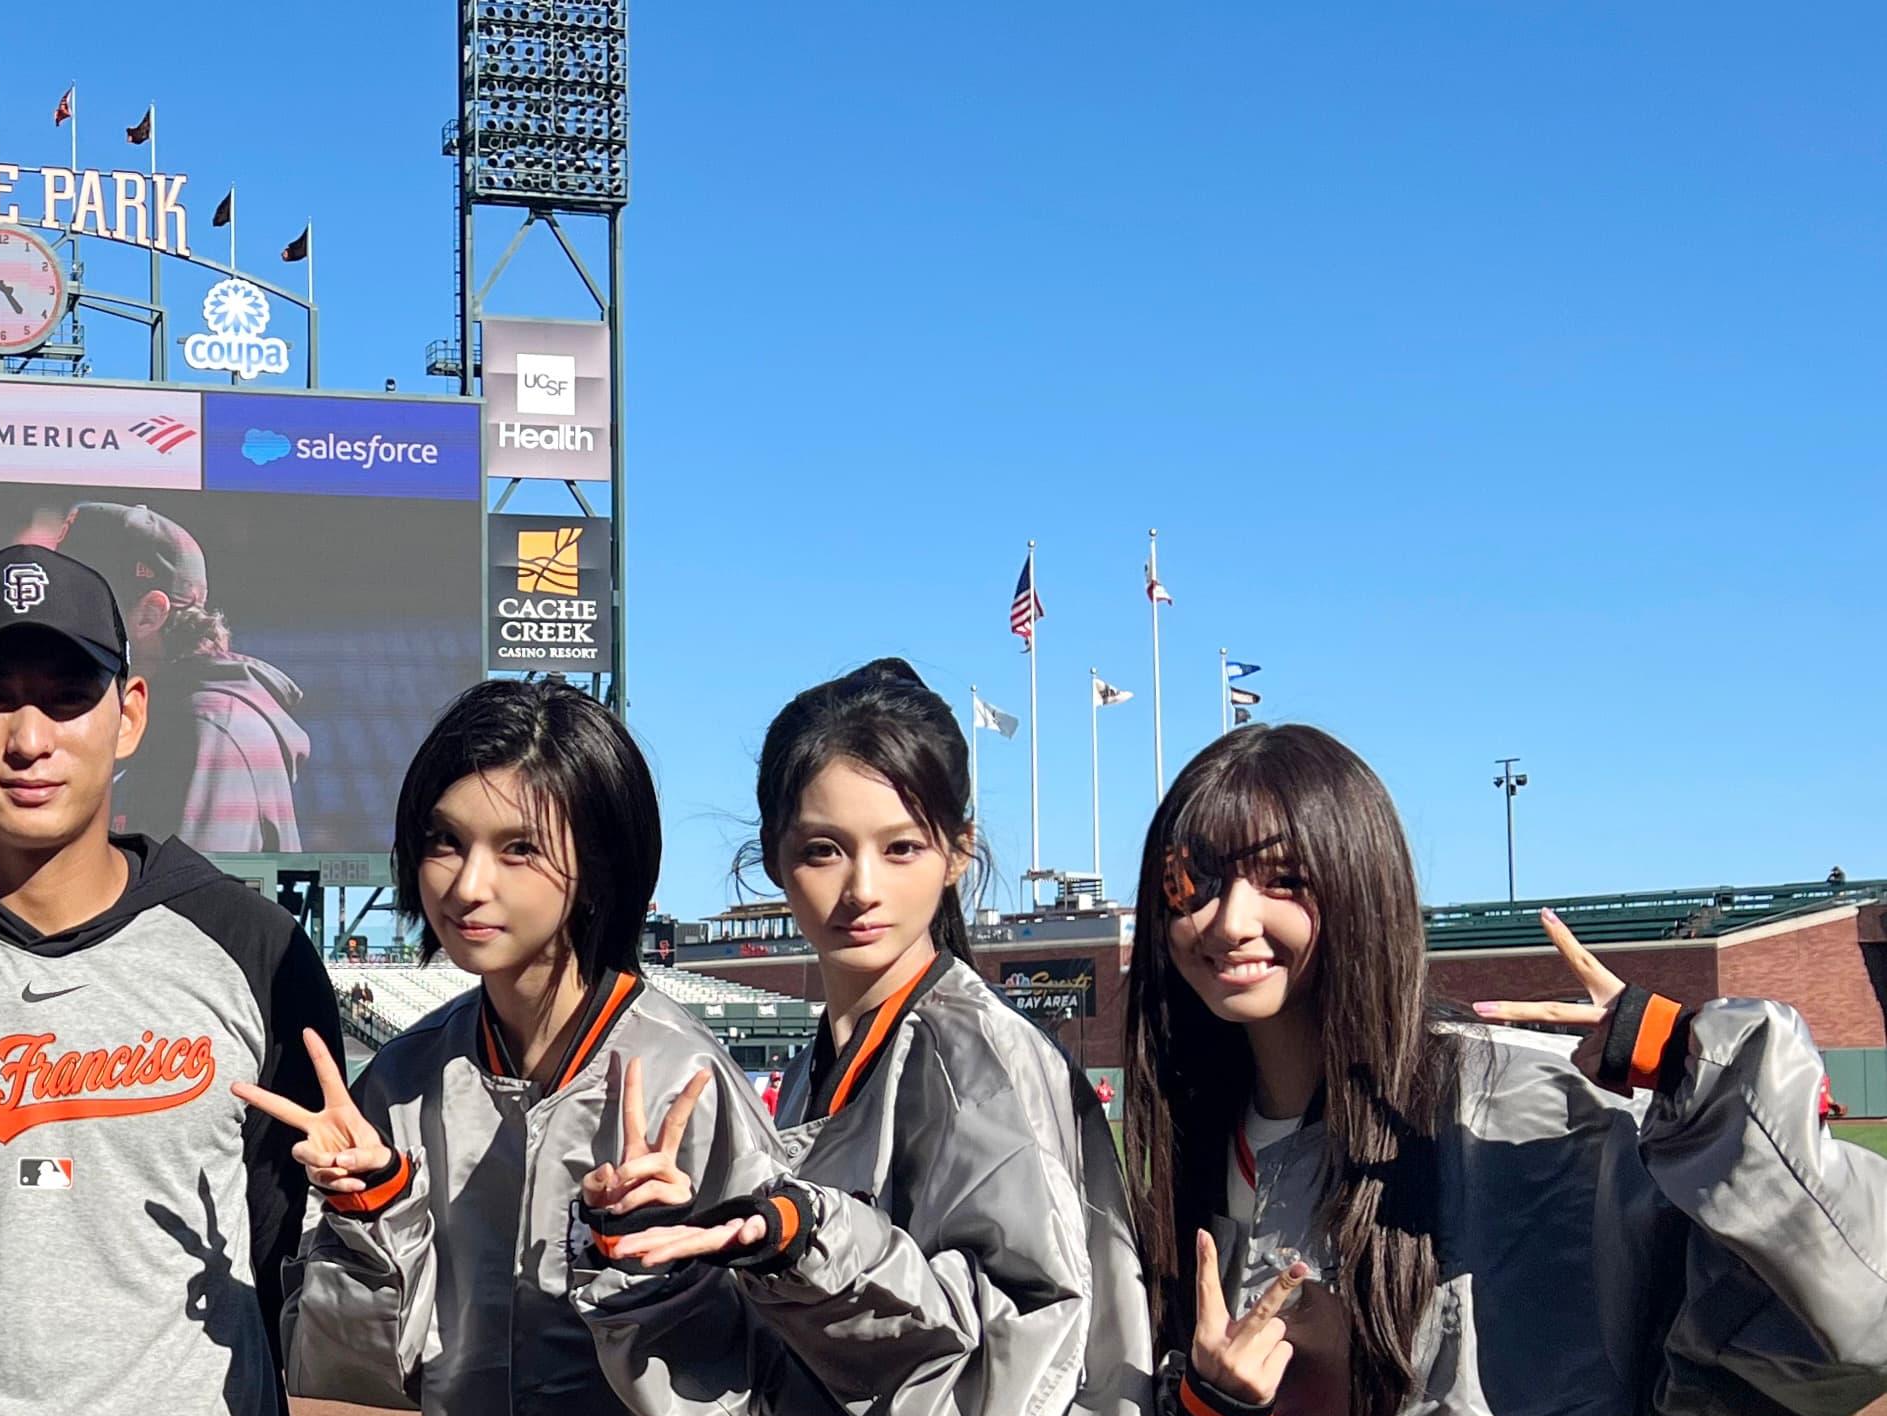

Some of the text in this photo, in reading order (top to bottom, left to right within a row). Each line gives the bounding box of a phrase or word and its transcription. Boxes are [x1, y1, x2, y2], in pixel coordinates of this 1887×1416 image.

[40, 166, 191, 258] PARK
[24, 242, 31, 252] 1
[41, 262, 49, 272] 2
[49, 286, 55, 296] 3
[41, 309, 49, 320] 4
[0, 331, 7, 341] 6
[23, 325, 31, 336] 5
[191, 338, 282, 372] coupa
[524, 373, 569, 396] UCSF
[498, 421, 594, 452] Health
[296, 433, 439, 469] salesforce
[3, 562, 48, 612] SF
[498, 598, 598, 620] CACHE
[501, 621, 595, 643] CREEK
[498, 647, 598, 659] CASINO RESORT
[1043, 995, 1078, 1008] AREA
